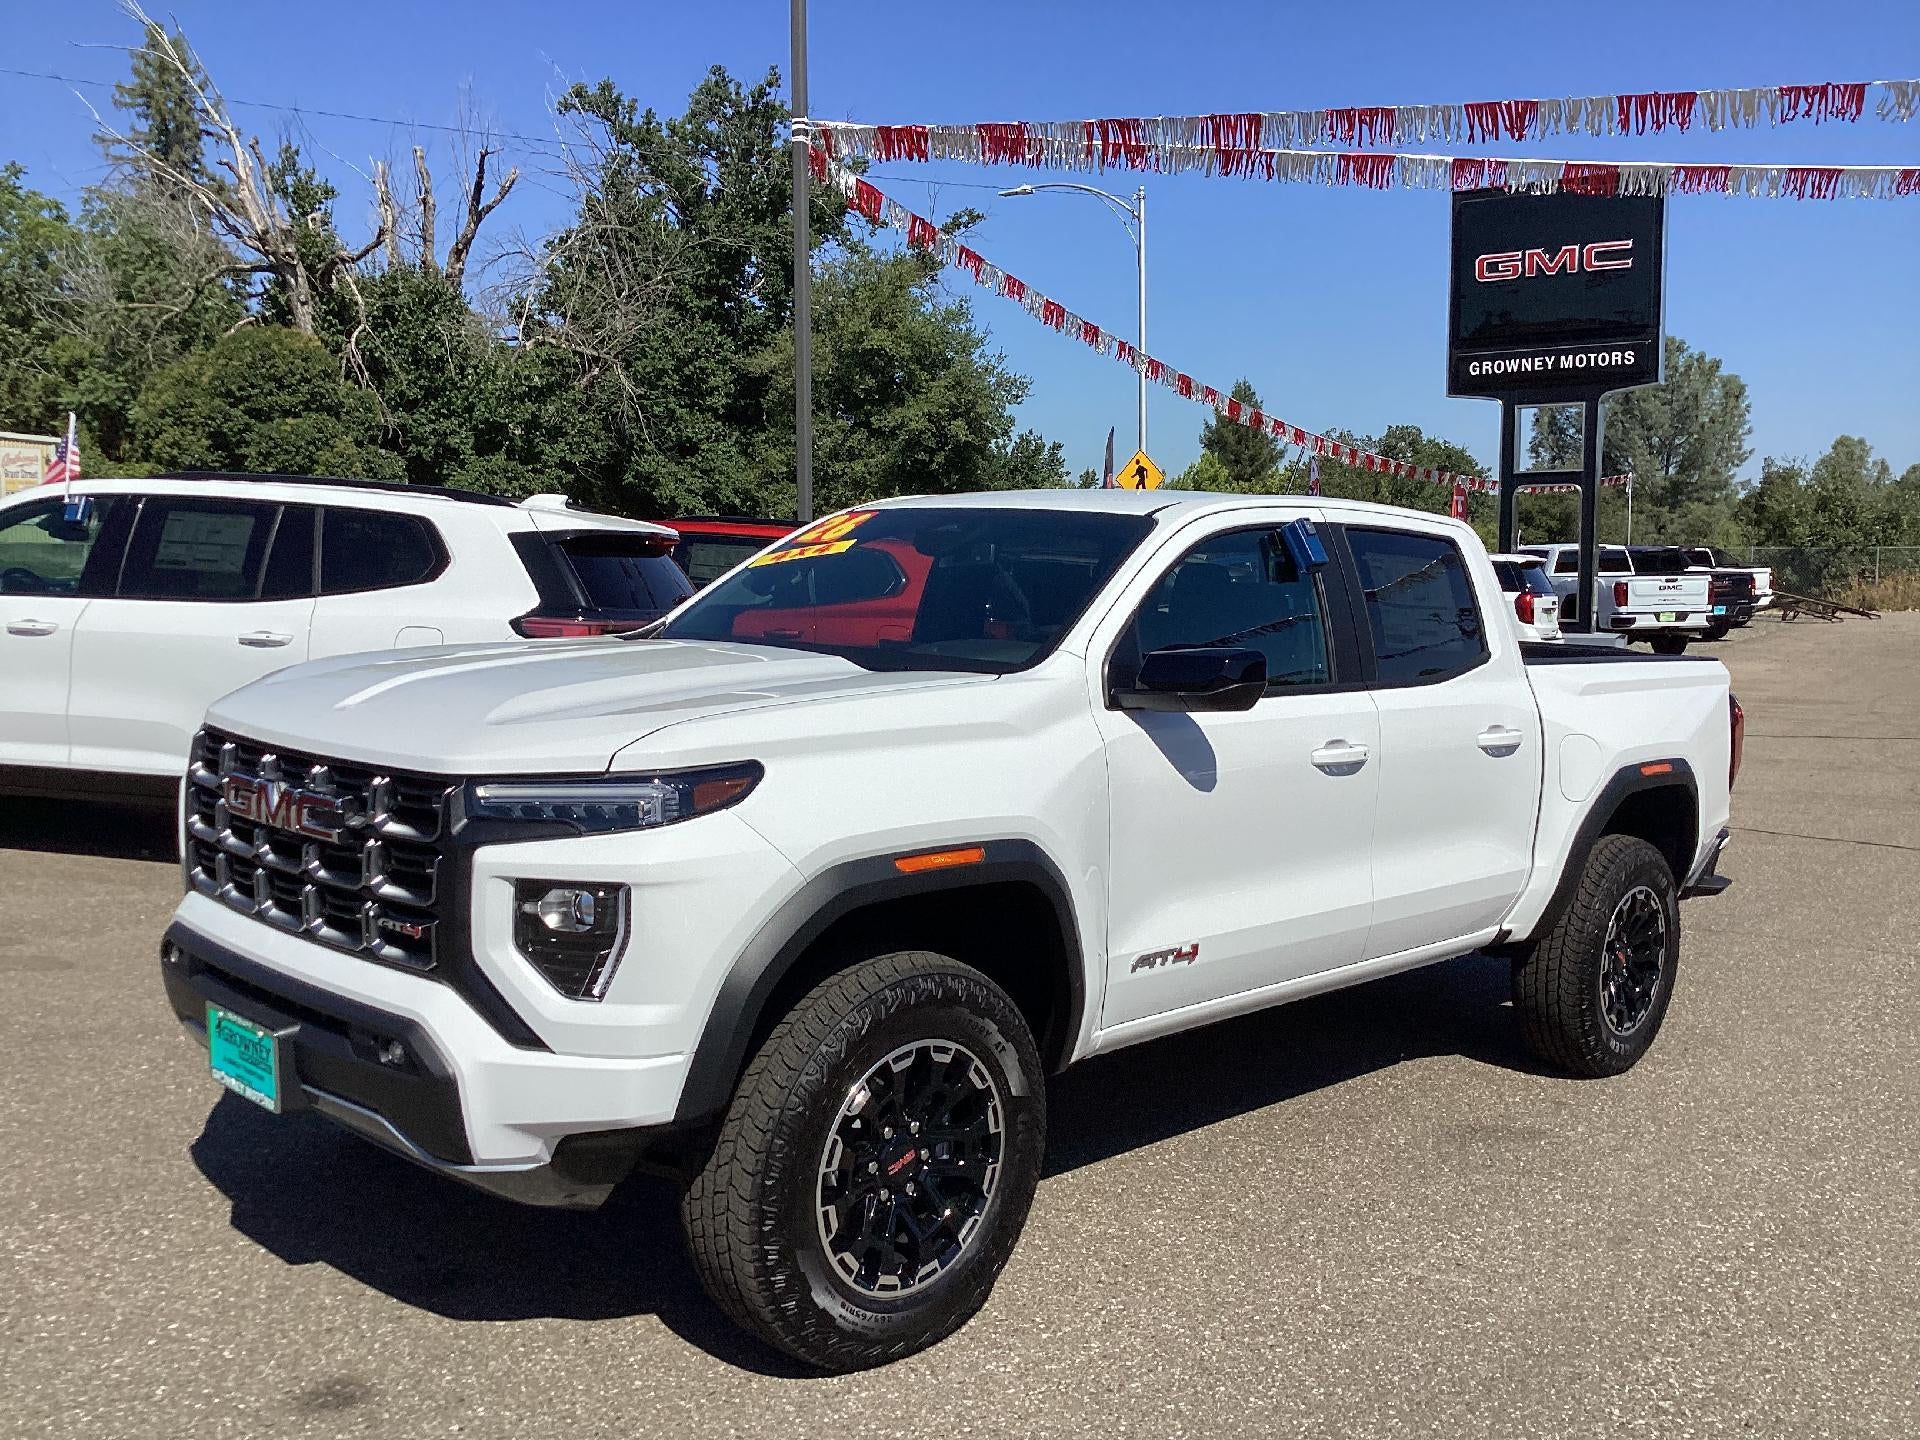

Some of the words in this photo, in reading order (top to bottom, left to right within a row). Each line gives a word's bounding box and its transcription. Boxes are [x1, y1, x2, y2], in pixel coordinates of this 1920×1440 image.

[1474, 239, 1634, 282] GMC
[1469, 356, 1555, 376] GROWNEY
[1560, 351, 1636, 370] MOTORS
[225, 773, 342, 843] GMC
[1130, 943, 1199, 974] AT4
